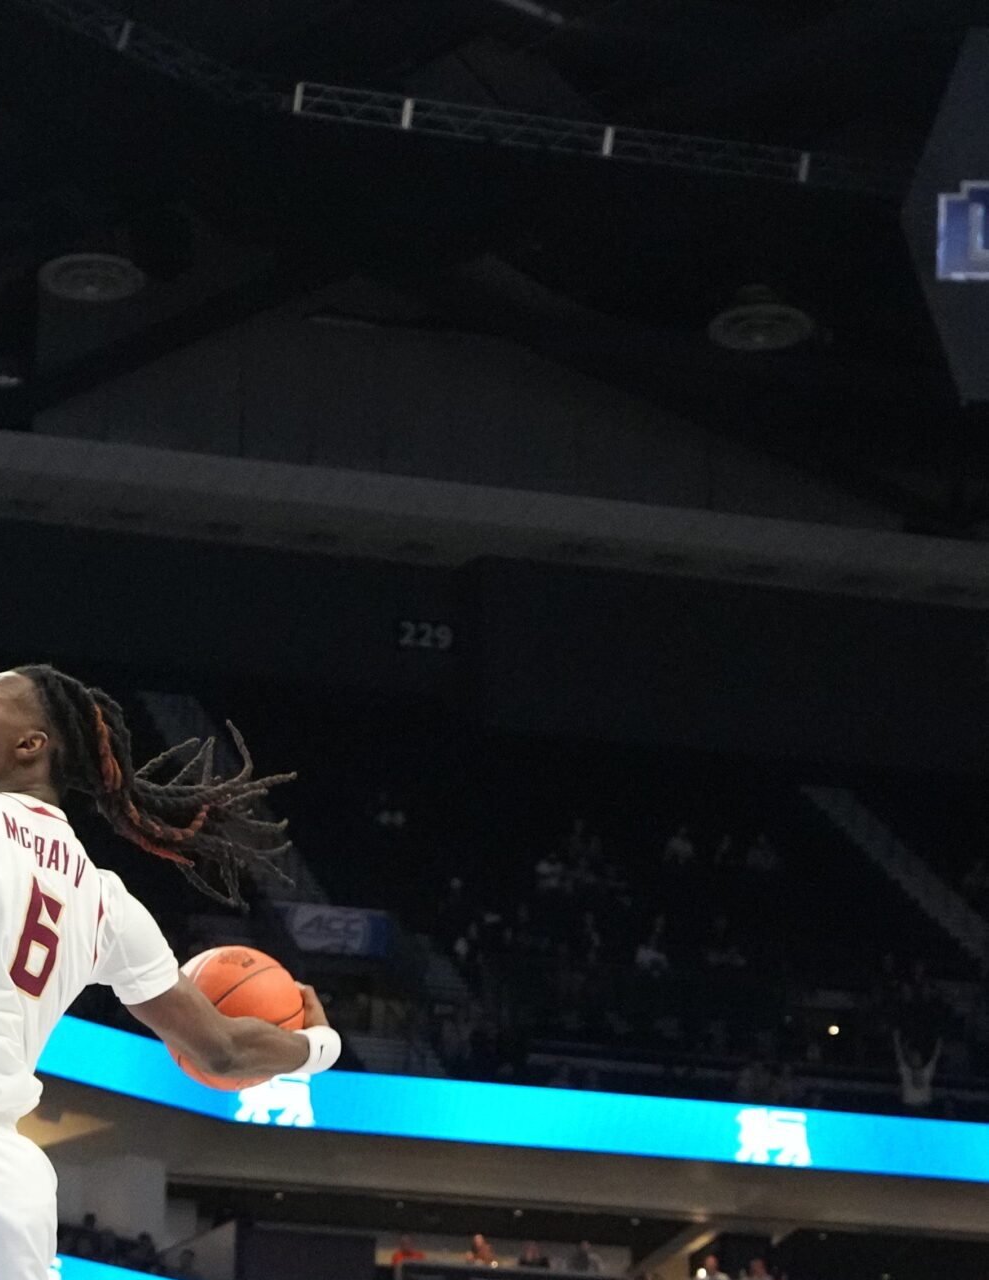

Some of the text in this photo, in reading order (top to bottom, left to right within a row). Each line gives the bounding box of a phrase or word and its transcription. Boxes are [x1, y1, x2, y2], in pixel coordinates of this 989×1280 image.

[399, 621, 453, 649] 229
[74, 853, 87, 889] V
[10, 873, 64, 999] 6
